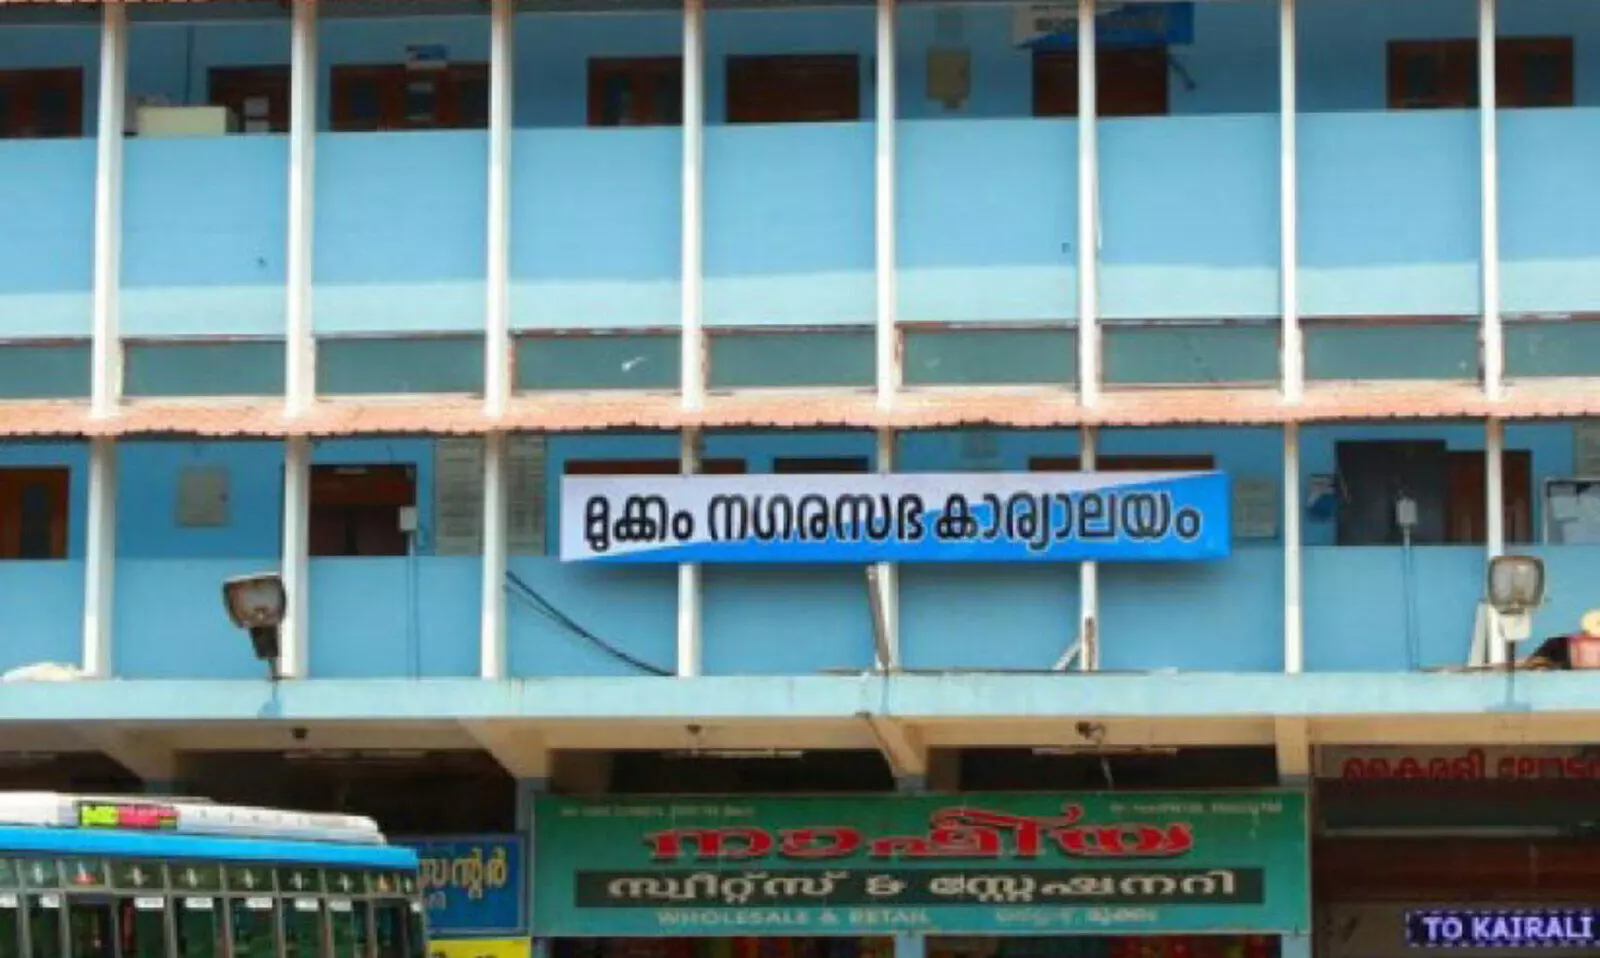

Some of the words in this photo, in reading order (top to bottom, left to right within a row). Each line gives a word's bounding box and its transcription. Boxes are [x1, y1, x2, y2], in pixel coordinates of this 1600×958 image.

[586, 494, 694, 552] മുക്കം
[707, 493, 924, 541] നഗരസഭ
[934, 492, 1201, 551] കാര്യാലയം
[866, 874, 905, 896] &
[657, 909, 810, 925] WHOLESALE
[849, 910, 930, 925] RETAIL
[1423, 916, 1463, 941] TO
[1471, 916, 1593, 941] KAIRALI
